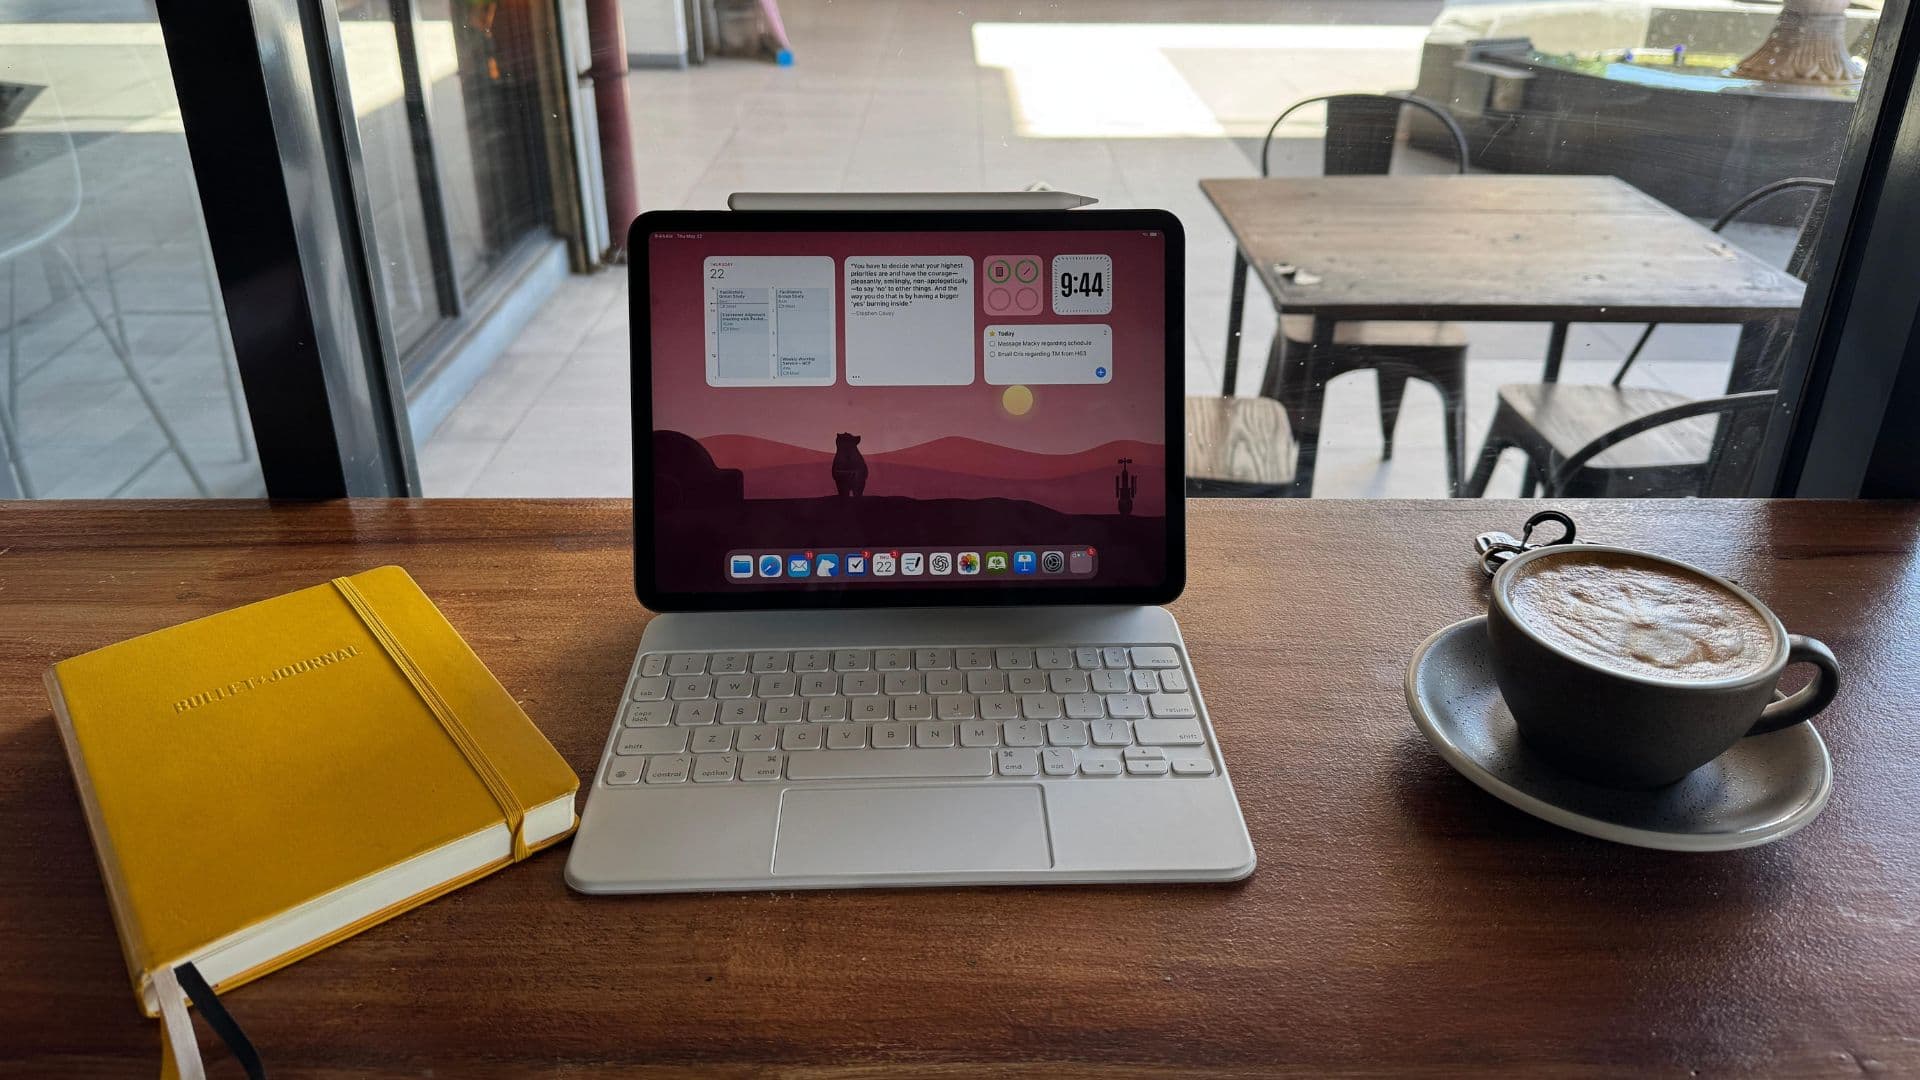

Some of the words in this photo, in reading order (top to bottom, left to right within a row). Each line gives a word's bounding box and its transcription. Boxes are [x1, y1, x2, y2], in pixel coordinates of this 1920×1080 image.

[710, 268, 725, 279] 22
[1061, 272, 1104, 297] 9:44
[877, 562, 892, 573] 22
[173, 679, 256, 714] BULLET
[268, 645, 361, 684] JOURNAL
[898, 679, 906, 687] Y
[866, 704, 874, 712] G
[843, 731, 851, 739] V
[974, 729, 984, 737] M
[708, 735, 717, 743] Z
[702, 770, 728, 778] option
